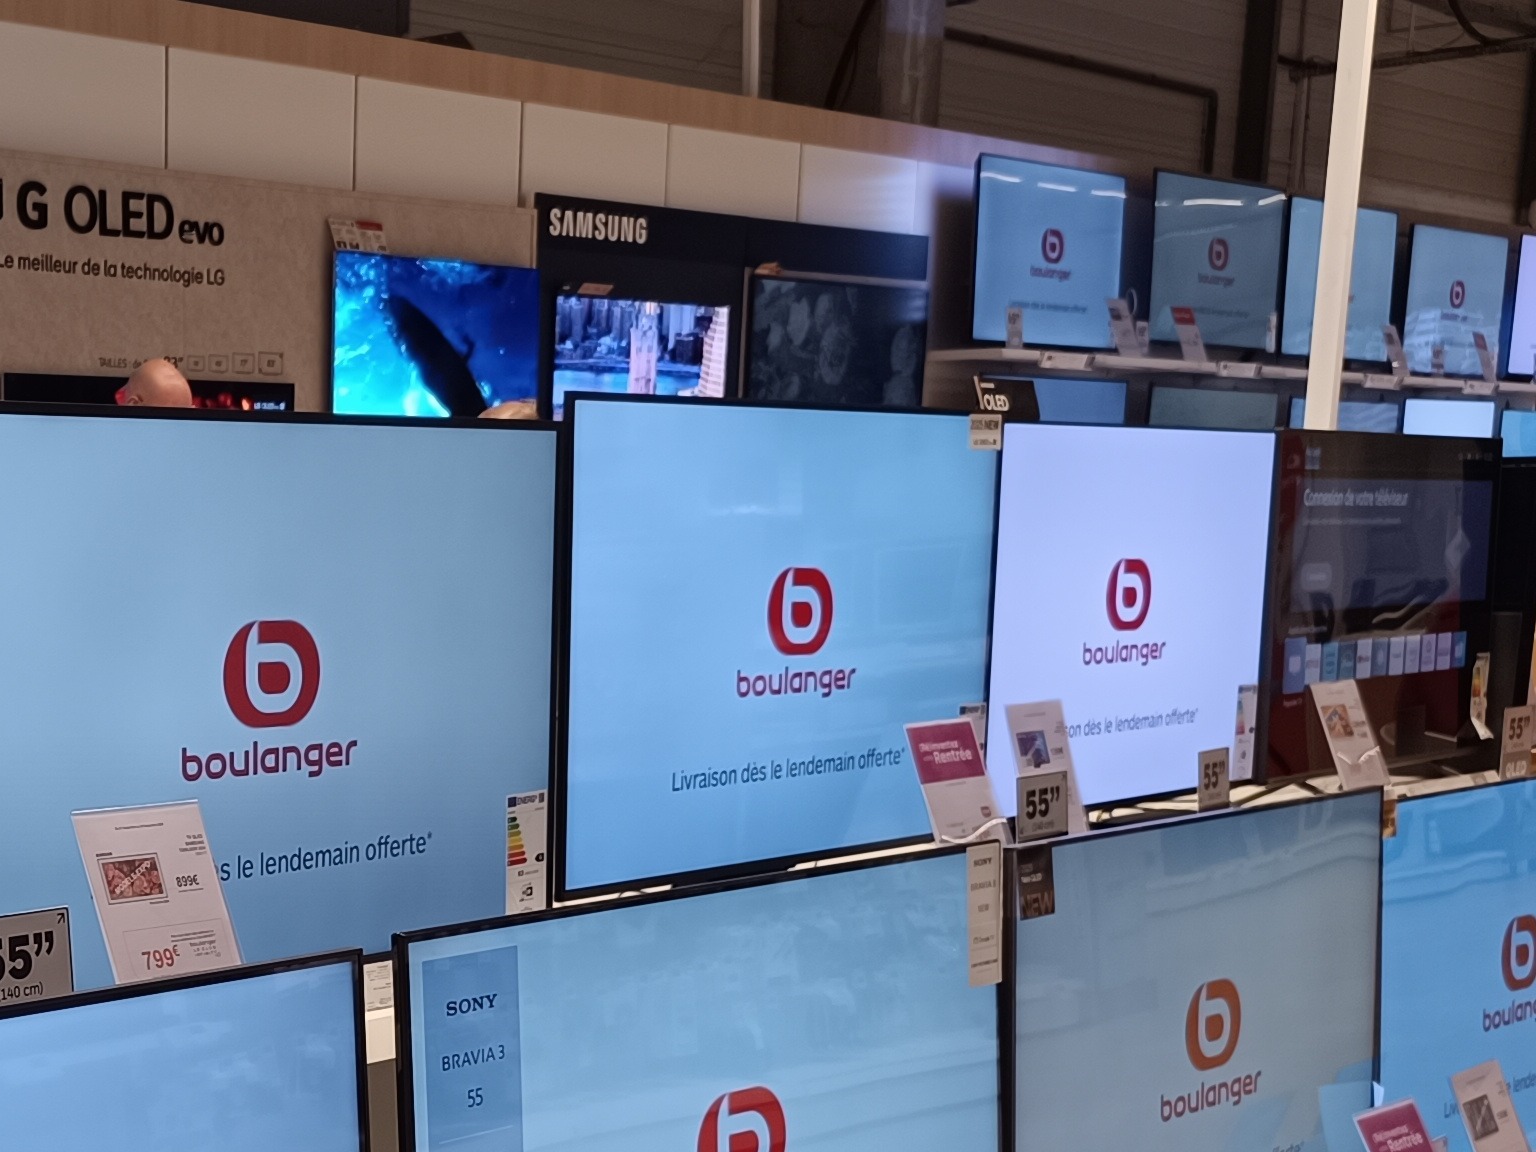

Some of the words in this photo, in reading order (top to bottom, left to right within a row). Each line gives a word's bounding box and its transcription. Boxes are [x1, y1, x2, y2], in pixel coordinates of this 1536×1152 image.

[63, 184, 174, 241] OLED
[177, 216, 225, 247] evo
[549, 208, 648, 244] SAMSUNG
[16, 252, 78, 277] meilleur
[81, 257, 101, 278] de
[103, 259, 118, 278] la
[120, 261, 203, 288] technologie
[206, 267, 226, 287] LG
[1082, 639, 1166, 667] boulanger
[736, 666, 857, 698] boulanger
[1084, 718, 1102, 737] dès
[1103, 716, 1113, 735] le
[1114, 711, 1164, 733] lendemain
[181, 739, 358, 782] boulanger
[671, 766, 737, 792] Livraison
[740, 761, 767, 785] dès
[770, 759, 782, 780] le
[785, 753, 855, 778] lendemain
[236, 854, 254, 880] le
[260, 840, 360, 876] lendemain
[973, 857, 992, 867] SONY
[176, 874, 199, 887] 899€
[141, 944, 180, 970] 799€
[23, 981, 44, 998] cm)
[446, 993, 498, 1017] SONY
[441, 1046, 496, 1072] BRAVIA
[498, 1044, 506, 1060] 3
[467, 1087, 484, 1108] 55
[1160, 1070, 1262, 1123] boulanger
